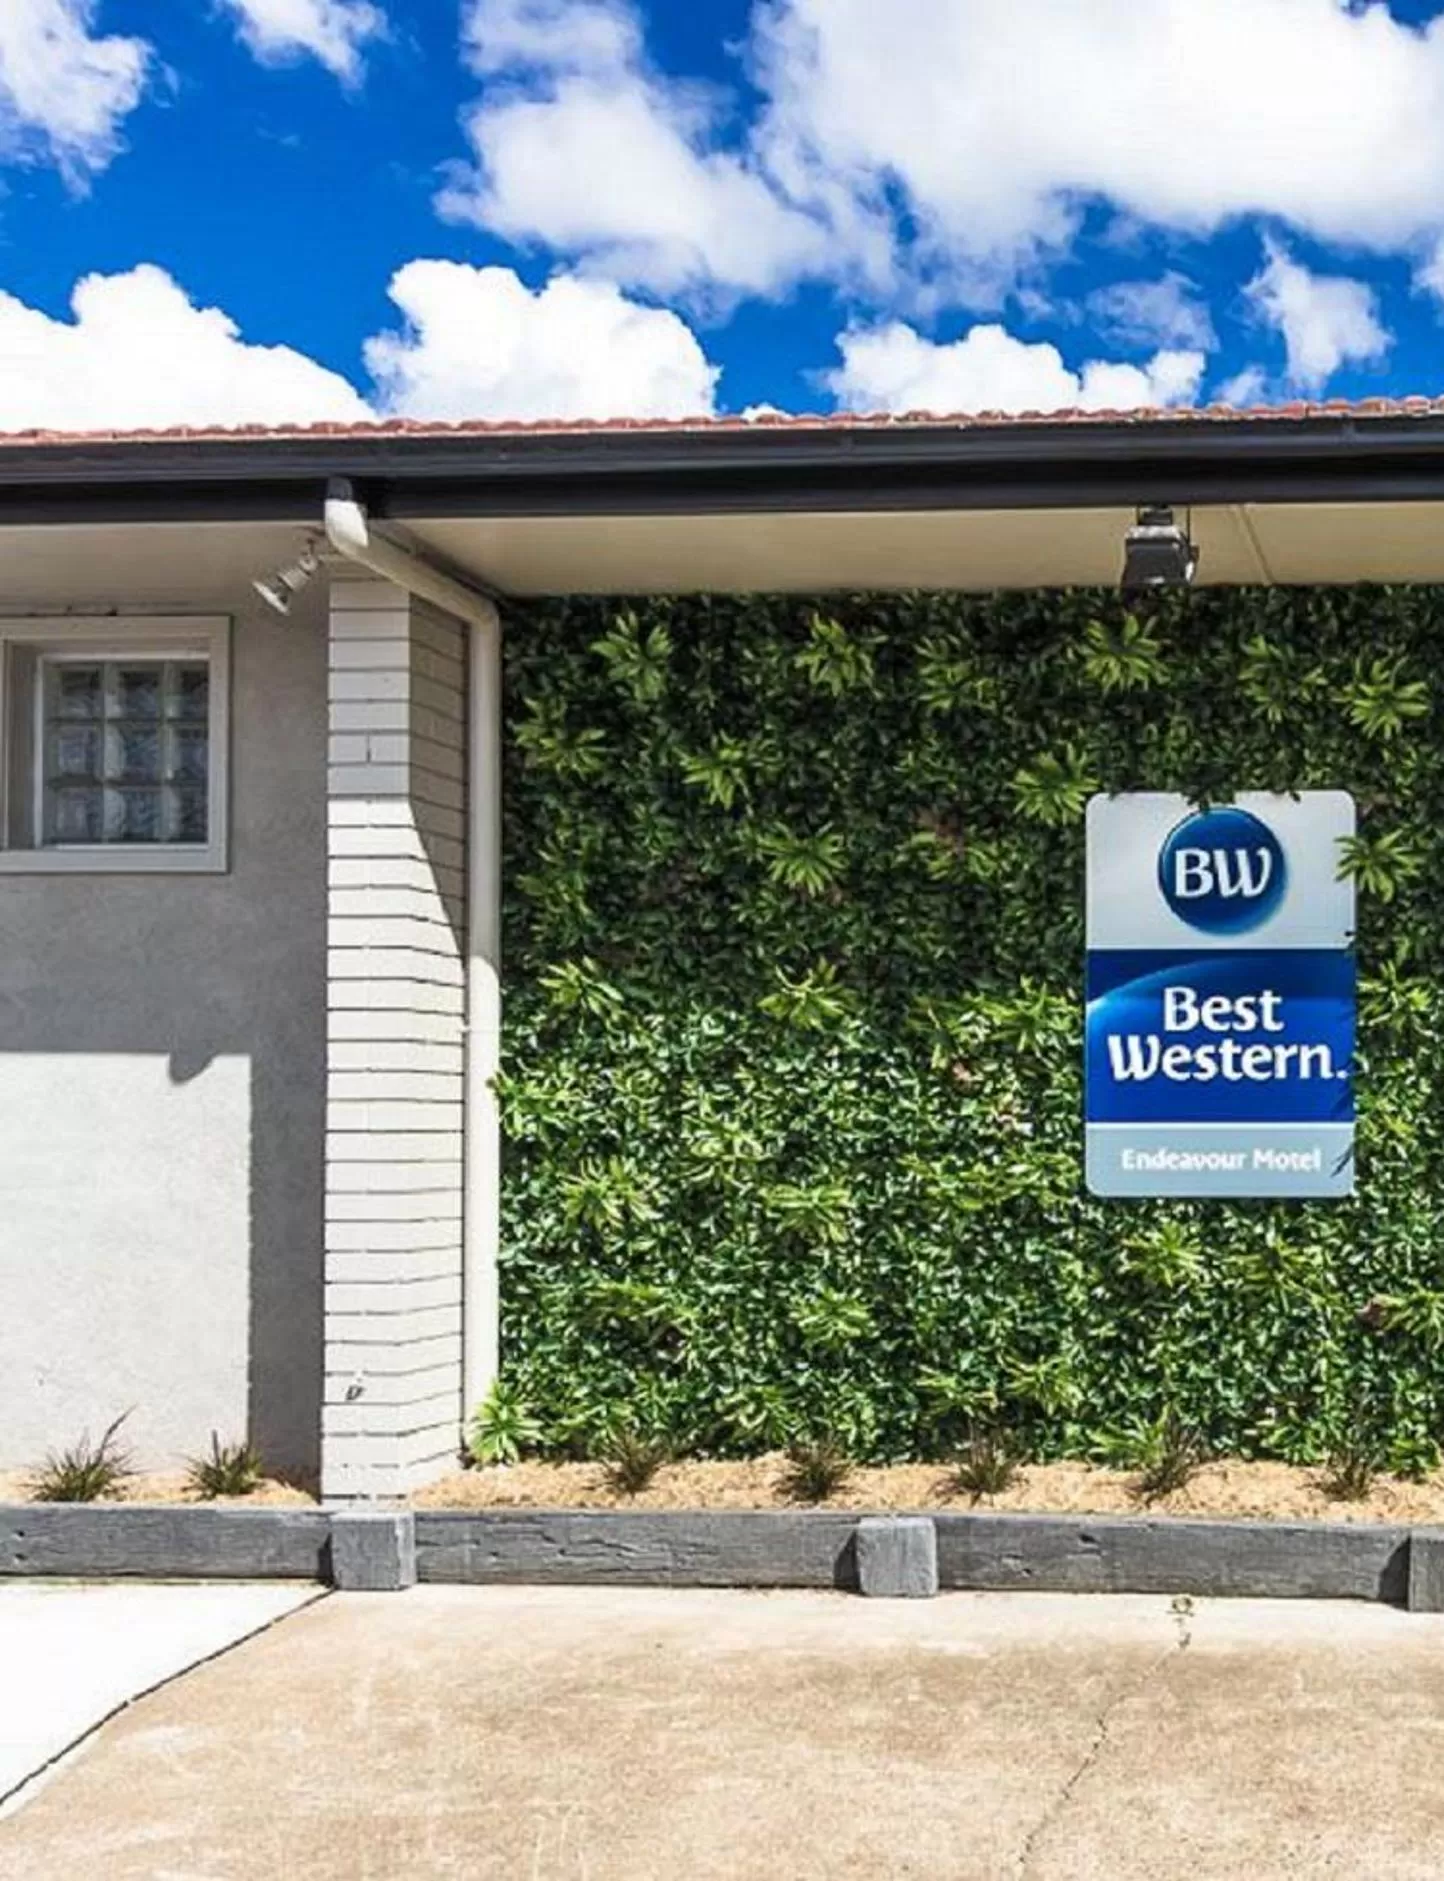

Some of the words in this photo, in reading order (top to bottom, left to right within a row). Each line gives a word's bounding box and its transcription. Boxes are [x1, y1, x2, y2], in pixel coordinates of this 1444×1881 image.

[1174, 847, 1272, 898] BW
[1164, 986, 1284, 1032] Best
[1121, 1147, 1246, 1171] Endeavour
[1252, 1147, 1322, 1172] Motel
